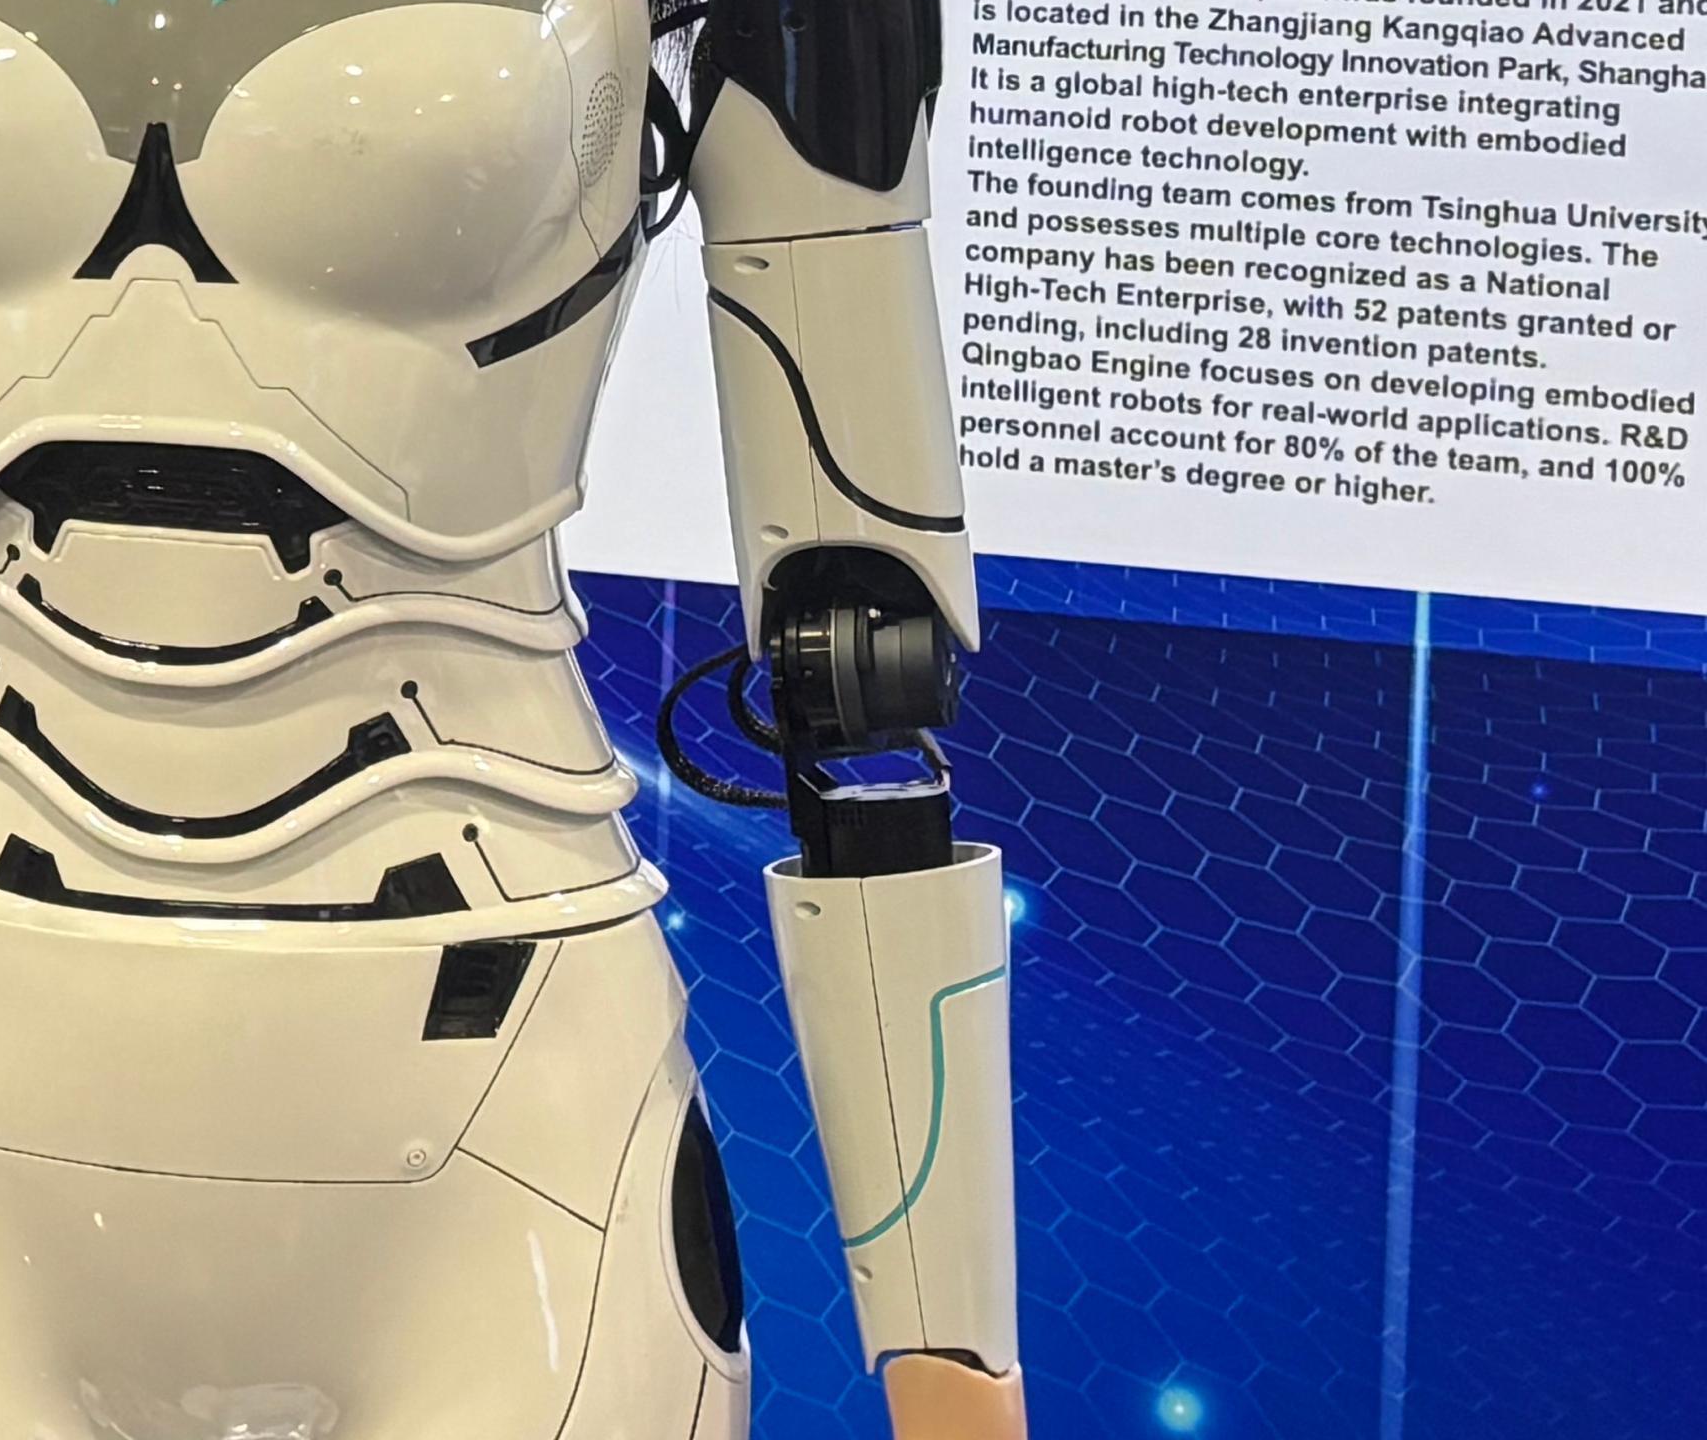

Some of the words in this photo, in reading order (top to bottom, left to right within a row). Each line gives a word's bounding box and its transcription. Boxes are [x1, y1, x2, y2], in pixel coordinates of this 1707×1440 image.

[1119, 3, 1145, 28] in
[1154, 4, 1200, 31] the
[1207, 6, 1372, 44] Zhangjiang
[1382, 13, 1525, 49] Kangqiao
[1531, 21, 1686, 52] Advanced
[972, 31, 1166, 70] Manufacturing
[1172, 40, 1335, 78] Technology
[1341, 48, 1490, 79] Innovation
[1497, 55, 1570, 88] Park,
[970, 65, 990, 91] It
[997, 66, 1021, 92] is
[1029, 74, 1046, 93] a
[1054, 69, 1143, 100] global
[1152, 74, 1289, 106] high-tech
[1297, 84, 1449, 116] enterprise
[1457, 89, 1621, 128] integrating
[968, 134, 1133, 169] intelligence
[1140, 144, 1310, 182] technology.
[969, 100, 1112, 131] humanoid
[1121, 109, 1199, 136] robot
[1206, 112, 1398, 147] development
[1405, 123, 1468, 150] with
[1476, 128, 1627, 158] embodied
[966, 169, 1019, 195] The
[1027, 171, 1154, 209] founding
[1161, 180, 1232, 208] team
[1240, 190, 1337, 214] comes
[1344, 190, 1413, 219] from
[1420, 194, 1557, 229] Tsinghua
[965, 205, 1018, 230] and
[1027, 212, 1180, 240] possesses
[1189, 219, 1307, 251] multiple
[1315, 229, 1381, 252] core
[1389, 229, 1592, 267] technologies.
[1601, 240, 1659, 268] The
[965, 243, 1096, 275] company
[1104, 245, 1156, 273] has
[1164, 249, 1235, 278] been
[1244, 260, 1407, 290] recognized
[1415, 271, 1451, 292] as
[1459, 274, 1477, 293] a
[1486, 269, 1611, 302] National
[964, 271, 1107, 305] High-Tech
[1116, 281, 1274, 320] Enterprise,
[1282, 293, 1344, 321] with
[1353, 297, 1388, 323] 52
[1396, 303, 1508, 331] patents
[1517, 313, 1634, 339] granted
[1642, 321, 1678, 342] or
[962, 309, 1086, 343] pending,
[1095, 314, 1229, 354] including
[1237, 325, 1272, 351] 28
[1281, 327, 1418, 361] invention
[1427, 341, 1547, 369] patents.
[961, 340, 1082, 374] Qingbao
[1091, 349, 1191, 383] Engine
[1199, 357, 1315, 389] focuses
[1323, 371, 1361, 393] on
[1370, 369, 1535, 411] developing
[1544, 384, 1696, 416] embodied
[961, 374, 1102, 411] intelligent
[1109, 387, 1203, 416] robots
[1211, 392, 1254, 420] for
[1261, 400, 1409, 431] real-world
[1416, 412, 1611, 446] applications.
[1620, 422, 1689, 451] R&D
[959, 415, 1101, 443] personnel
[1109, 425, 1227, 453] account
[1233, 429, 1277, 456] for
[1283, 434, 1346, 463] 80%
[1354, 439, 1387, 465] of
[1391, 442, 1439, 469] the
[1446, 447, 1530, 480] team,
[1537, 456, 1595, 481] and
[1604, 457, 1686, 489] 100%
[959, 443, 1020, 471] hold
[1028, 454, 1045, 473] a
[1185, 461, 1286, 495] degree
[1294, 475, 1327, 495] or
[1334, 472, 1435, 506] higher.
